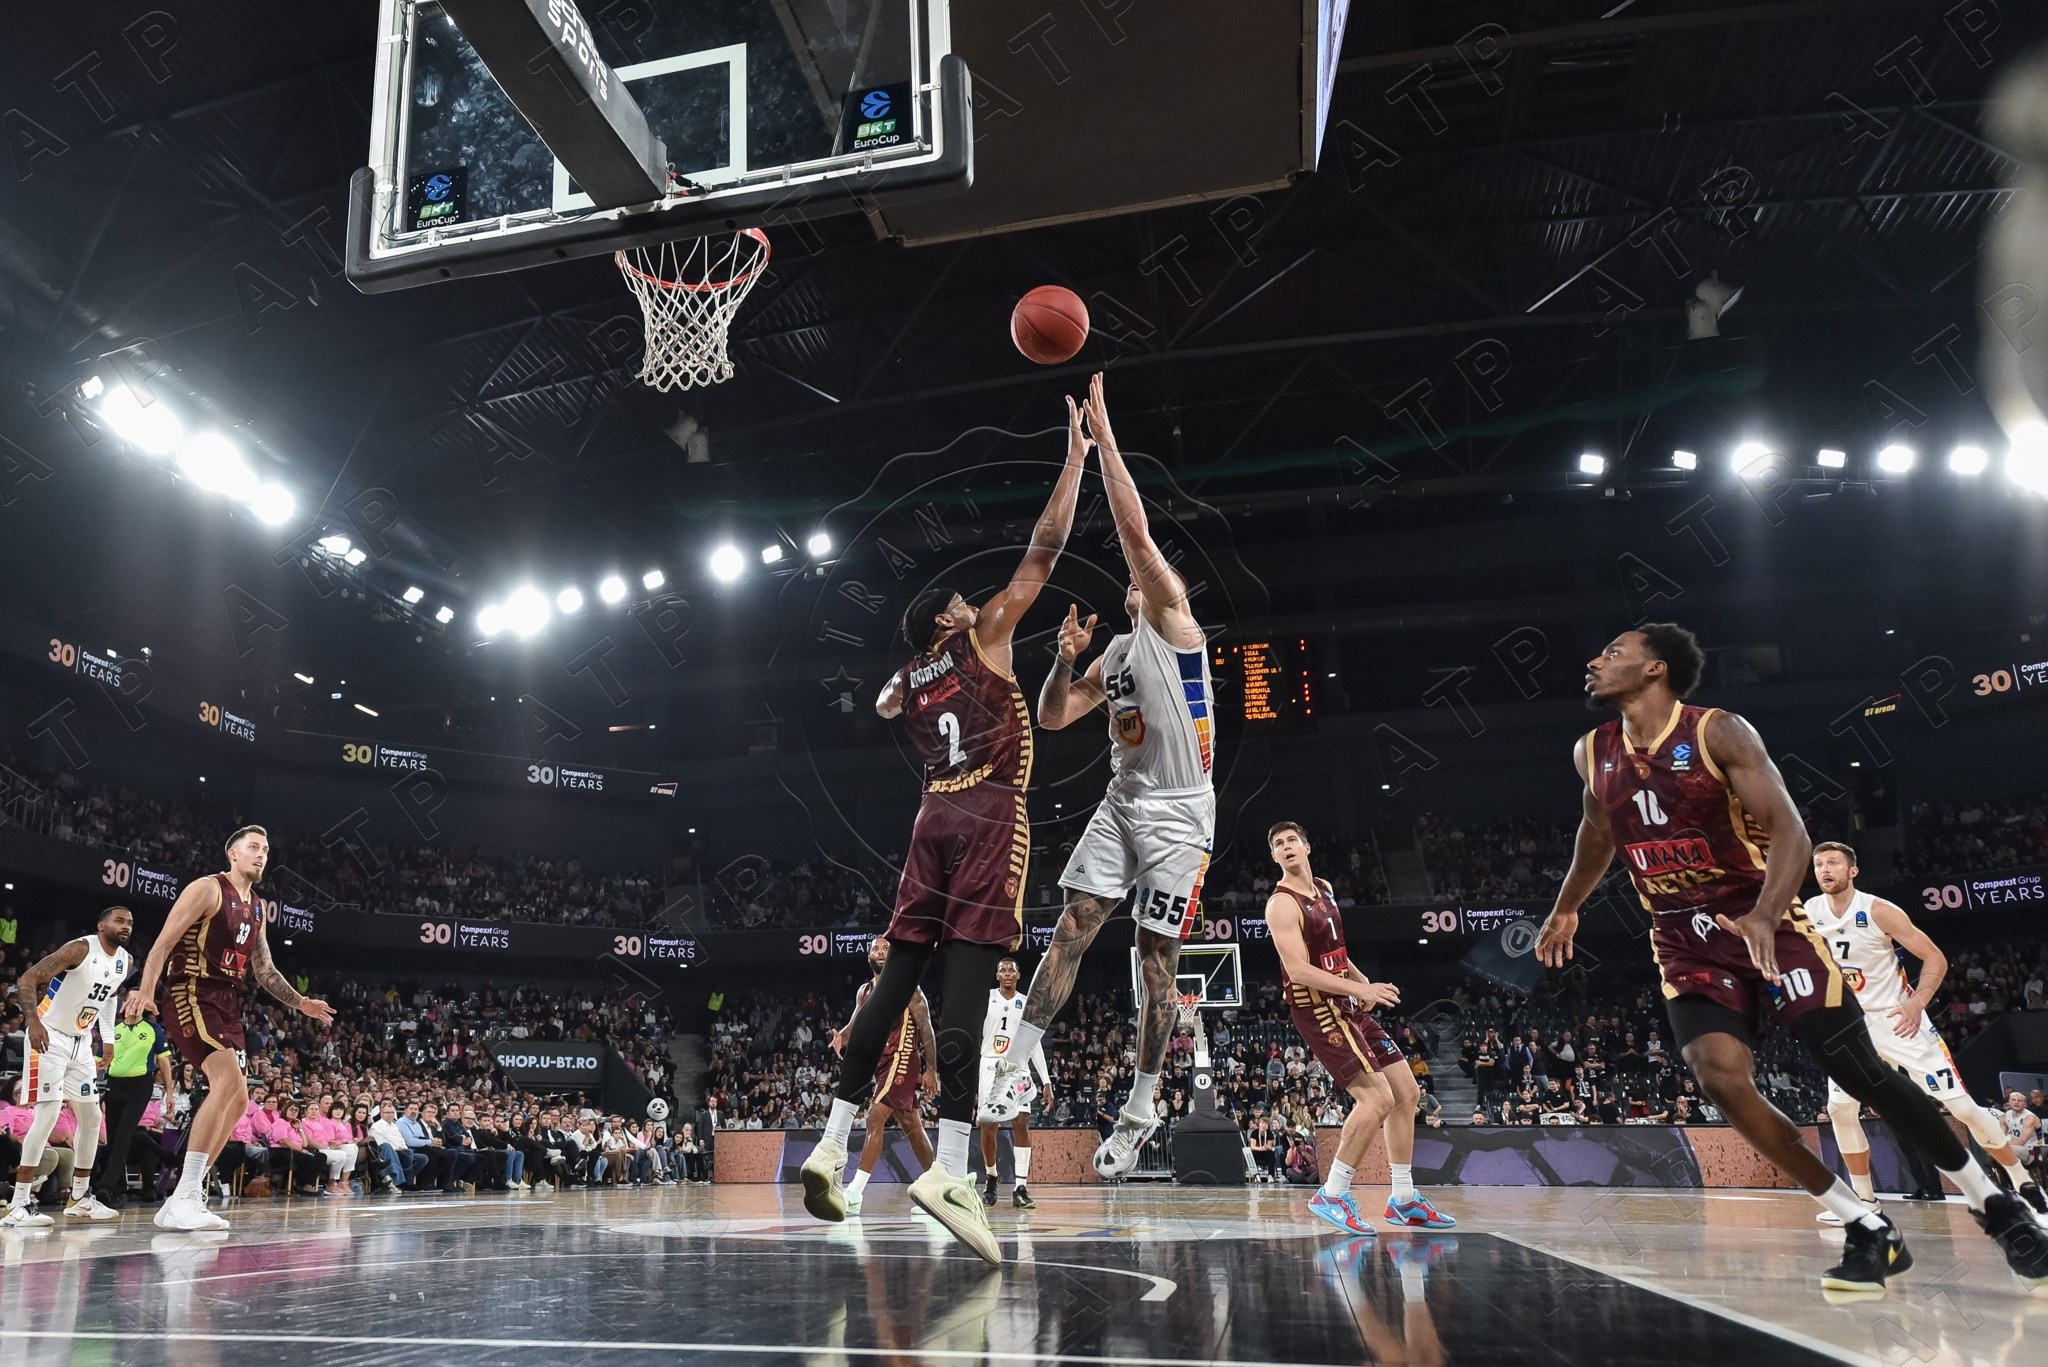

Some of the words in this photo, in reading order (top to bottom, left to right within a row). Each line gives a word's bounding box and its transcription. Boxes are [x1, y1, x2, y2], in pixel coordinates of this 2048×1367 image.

[857, 119, 897, 138] BKT
[854, 134, 900, 149] EuroCup
[417, 216, 456, 229] EuroCup
[49, 639, 75, 667] 30
[82, 661, 121, 687] YEARS
[910, 651, 954, 689] NORTON
[1105, 664, 1135, 701] 55
[1972, 669, 2012, 696] 30
[199, 701, 220, 726] 30
[1123, 715, 1138, 731] BT
[224, 720, 255, 742] YEARS
[938, 711, 967, 767] 2
[342, 743, 372, 764] 30
[380, 756, 427, 771] YEARS
[527, 764, 554, 785] 30
[561, 777, 603, 791] YEARS
[1631, 789, 1669, 826] 10
[1631, 843, 1706, 871] UMANA
[102, 859, 130, 888] 30
[164, 871, 178, 885] Grup
[2017, 876, 2041, 885] Grup
[136, 877, 177, 900] YEARS
[1922, 884, 1963, 911] 30
[1975, 885, 2045, 905] YEARS
[1150, 888, 1188, 926] 55
[1505, 908, 1525, 916] Grup
[282, 914, 314, 933] YEARS
[1204, 919, 1232, 940] 30
[1327, 916, 1338, 940] 1
[1421, 910, 1457, 932] 30
[236, 923, 250, 945] 33
[420, 922, 451, 944] 30
[460, 935, 508, 948] YEARS
[493, 928, 509, 937] Grup
[613, 935, 642, 956] 30
[650, 947, 695, 959] YEARS
[678, 939, 695, 948] Grup
[798, 934, 828, 954] 30
[1836, 941, 1851, 960] 7
[88, 981, 111, 1002] 35
[1780, 967, 1815, 1002] 10
[81, 1010, 96, 1021] BT
[1001, 1016, 1007, 1031] 1
[996, 1039, 1007, 1047] BT
[497, 1054, 598, 1070] SHOP.U-BT.RO
[1936, 1068, 1954, 1090] 7
